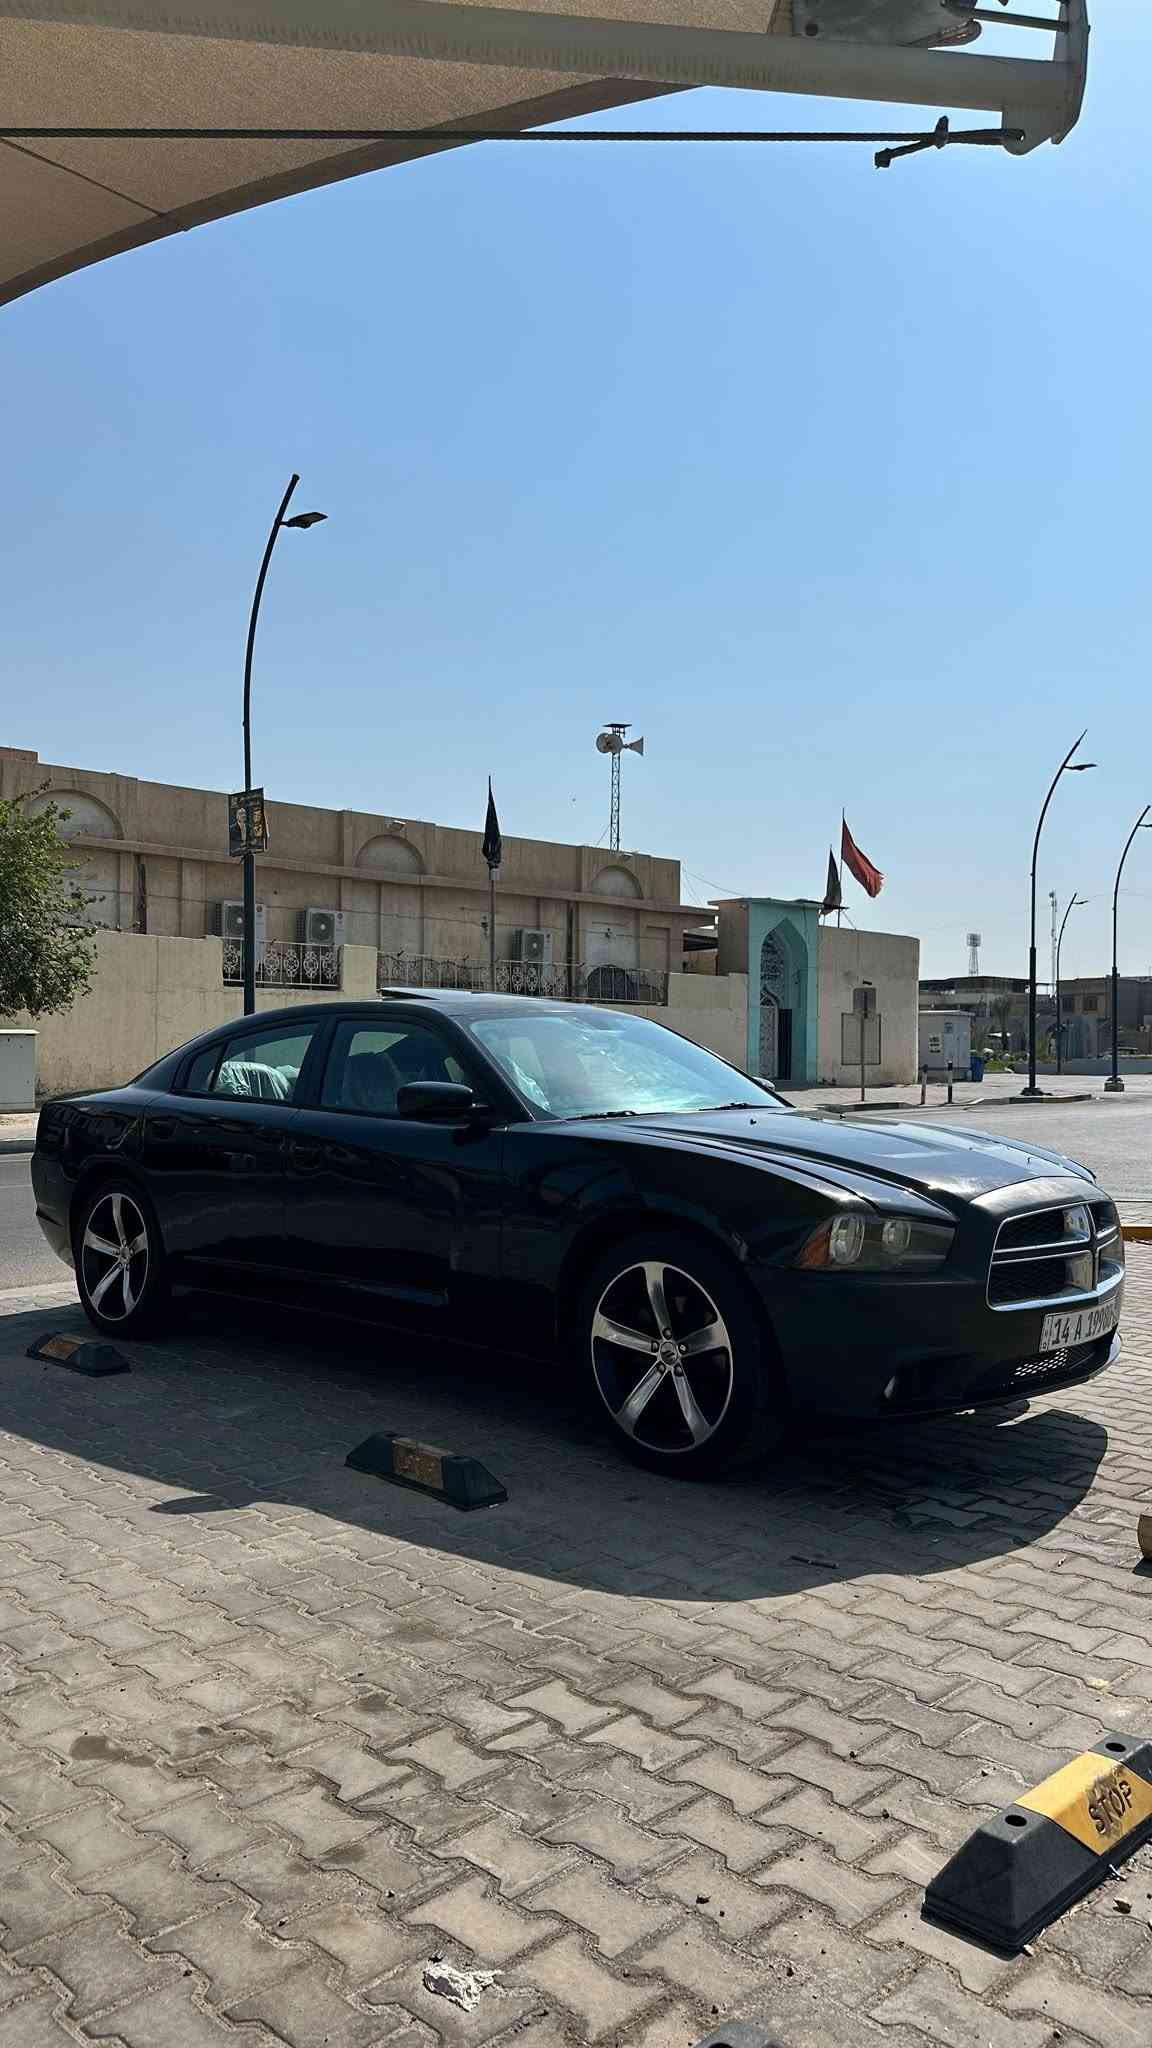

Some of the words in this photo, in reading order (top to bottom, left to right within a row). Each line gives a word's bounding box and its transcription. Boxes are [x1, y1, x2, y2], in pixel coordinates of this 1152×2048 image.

[1052, 1317, 1070, 1345] 14
[1073, 1314, 1083, 1341] A
[1088, 1779, 1133, 1834] STOP
